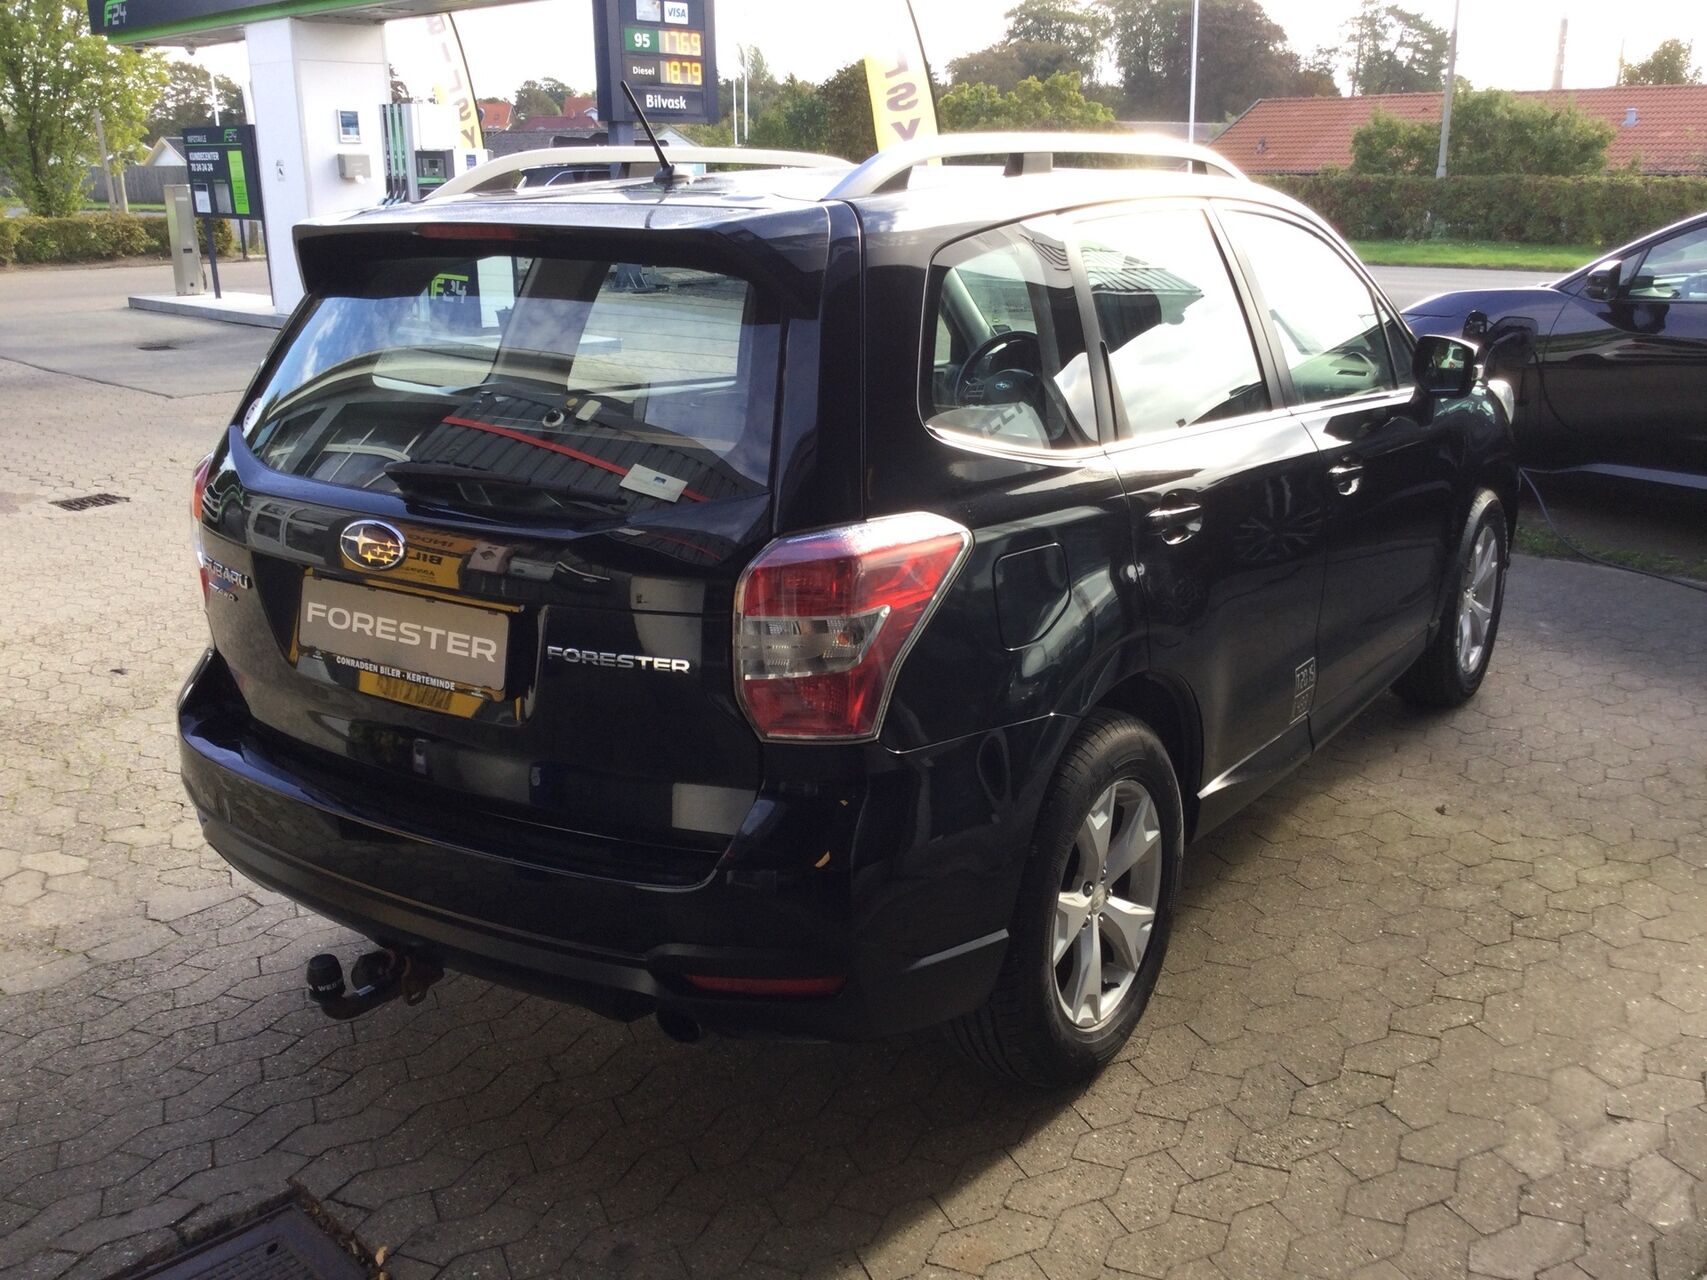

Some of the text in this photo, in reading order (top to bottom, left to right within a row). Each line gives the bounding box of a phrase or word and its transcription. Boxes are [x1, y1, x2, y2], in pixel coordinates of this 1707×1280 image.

[104, 0, 127, 27] F24
[667, 8, 687, 18] VISA
[634, 33, 650, 48] 95
[632, 66, 655, 76] Diesel
[645, 94, 687, 110] Bilvask
[306, 602, 498, 663] FORESTER
[547, 645, 691, 674] FORESTER
[336, 655, 378, 673] CONRADSEN
[379, 666, 401, 678] BILER
[406, 672, 456, 691] KERTEMINDE
